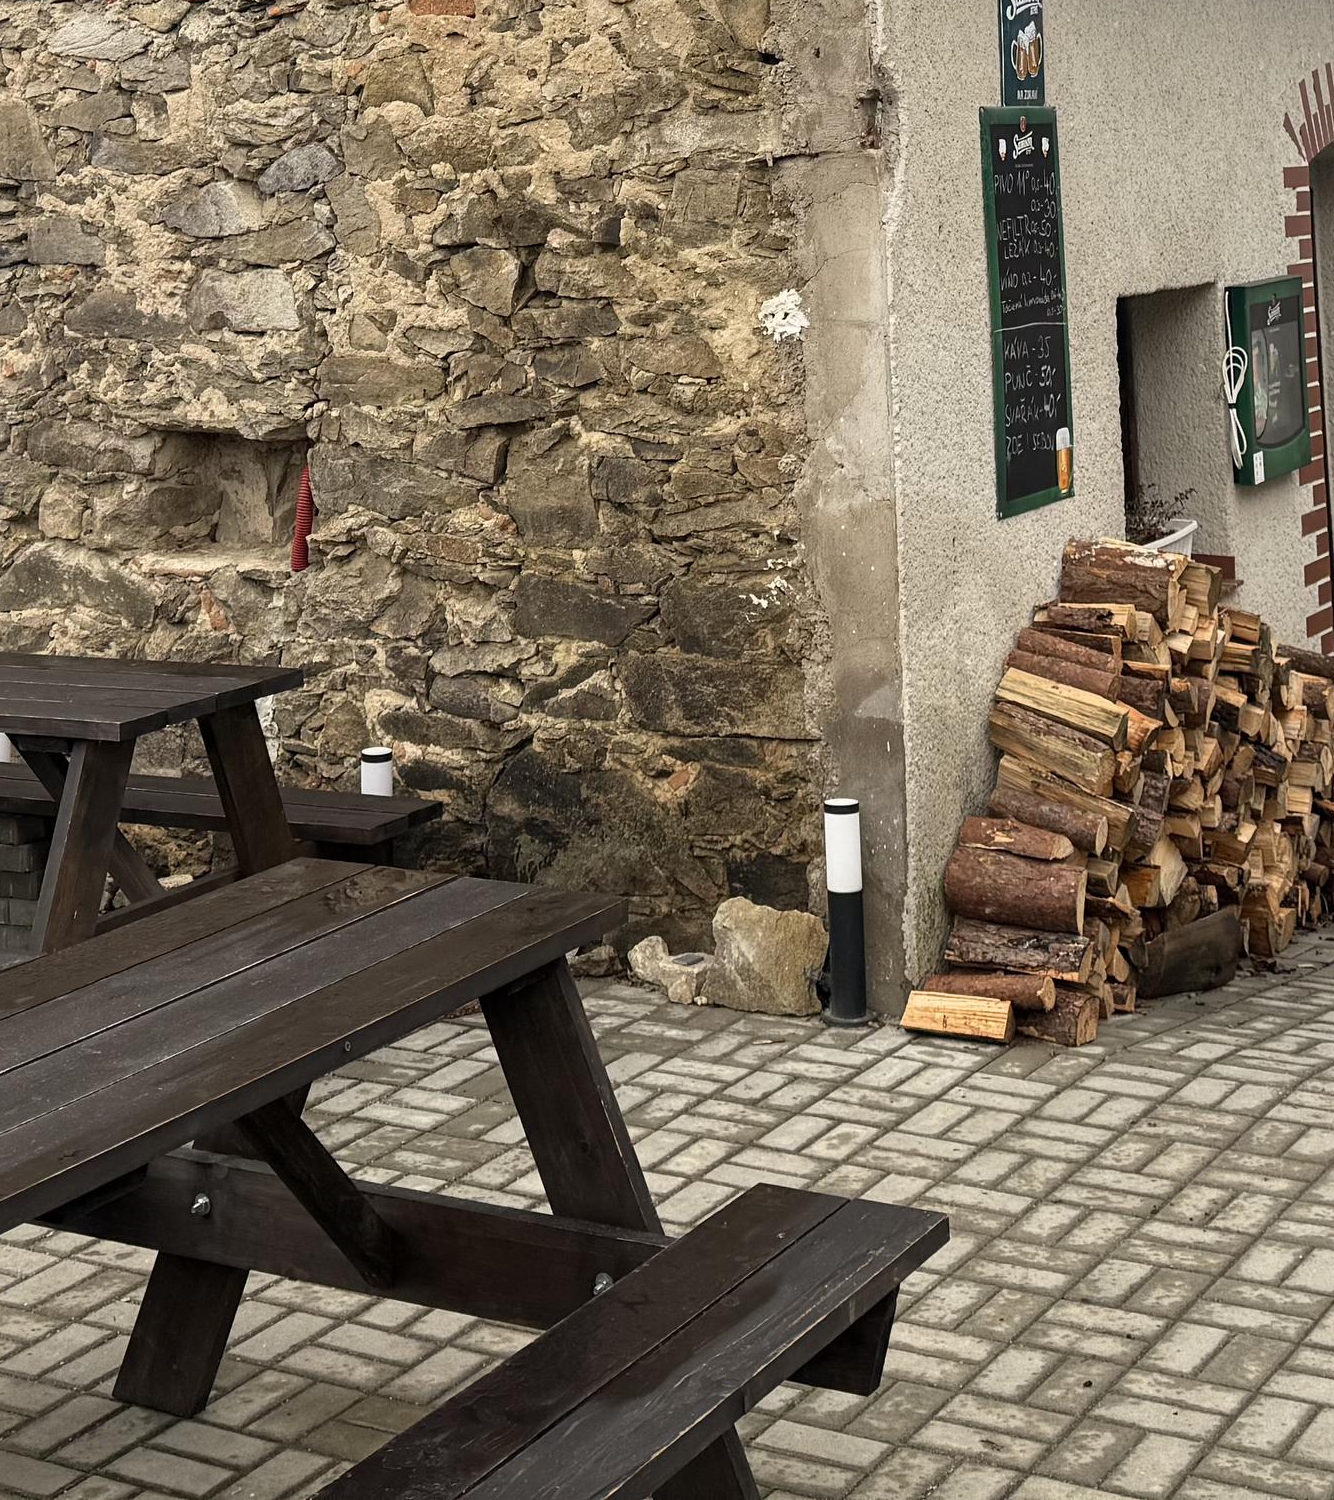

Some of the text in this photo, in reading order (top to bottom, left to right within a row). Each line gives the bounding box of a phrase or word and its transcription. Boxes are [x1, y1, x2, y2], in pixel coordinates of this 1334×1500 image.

[994, 173, 1014, 195] PIVO
[1000, 266, 1018, 291] VÍNO
[1004, 335, 1029, 360] KÁVA
[1005, 365, 1033, 393] PUNČ
